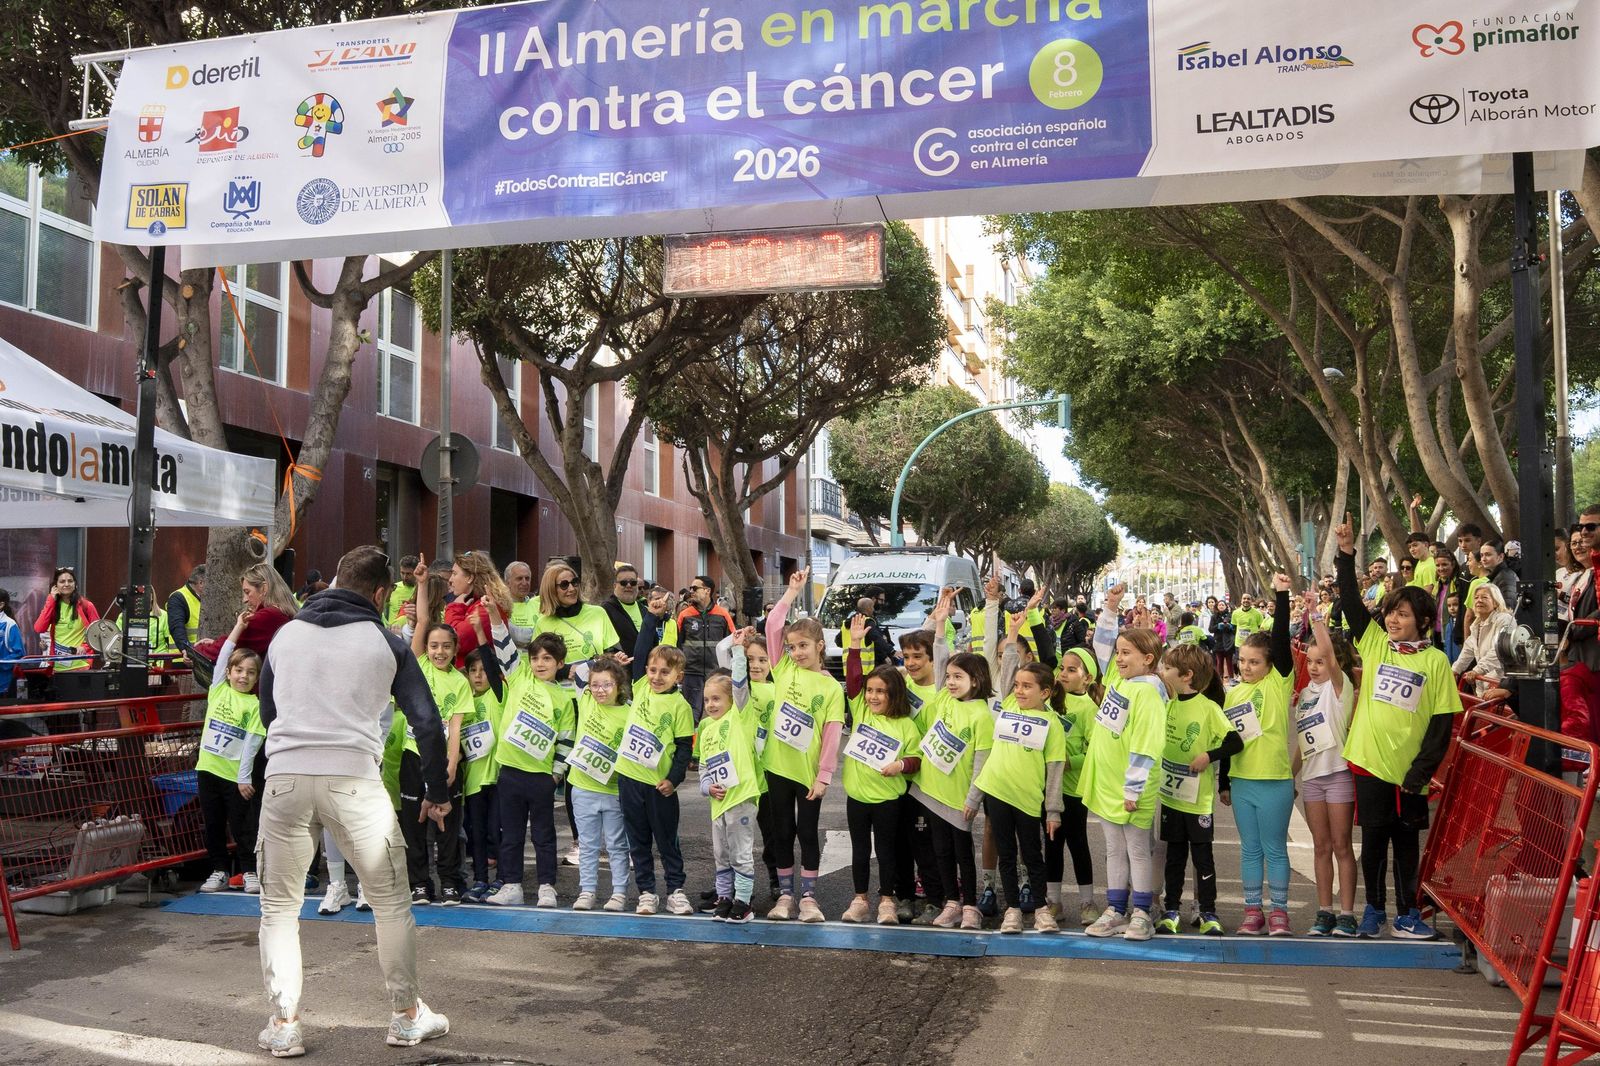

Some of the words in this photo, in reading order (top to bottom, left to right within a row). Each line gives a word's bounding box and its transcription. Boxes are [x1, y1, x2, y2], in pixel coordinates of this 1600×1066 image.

[1472, 11, 1574, 28] FUNDACIÓN
[336, 38, 390, 47] TRANSPORTES
[478, 32, 506, 77] II
[513, 8, 744, 72] Almería
[760, 7, 835, 48] en
[1472, 24, 1580, 52] primaflor
[1177, 47, 1248, 72] Isabel
[1255, 44, 1342, 66] Alonso
[192, 56, 260, 86] deretil
[1053, 51, 1078, 88] 8
[499, 86, 686, 141] contra
[706, 71, 765, 121] el
[783, 62, 1005, 116] cáncer
[1048, 88, 1083, 100] Febrero
[1468, 88, 1529, 104] Toyota
[1196, 103, 1336, 135] LEALTADIS
[1469, 106, 1539, 122] Alborán
[1544, 103, 1597, 118] Motor
[400, 131, 422, 141] 2005
[968, 122, 1043, 139] asociación
[1045, 117, 1107, 135] española
[970, 140, 1014, 154] contra
[1016, 137, 1029, 151] el
[1031, 135, 1079, 149] cáncer
[1226, 130, 1305, 146] ABOGADOS
[124, 147, 170, 160] ALMERÍA
[136, 159, 160, 167] CIUDAD
[970, 159, 989, 170] en
[992, 153, 1049, 169] Almería
[733, 145, 821, 182] 2026
[342, 182, 429, 199] UNIVERSIDAD
[495, 168, 668, 196] #TodosContraElCáncer
[135, 207, 146, 218] DE
[149, 206, 181, 218] CABRAS
[341, 199, 360, 213] DE
[363, 195, 427, 211] ALMERÍA
[1, 420, 178, 495] ndolamta
[1378, 678, 1413, 699] 570
[514, 723, 549, 751] 1408
[781, 719, 802, 737] 30
[1011, 722, 1033, 737] 19
[213, 733, 234, 748] 17
[464, 736, 482, 752] 16
[1304, 731, 1315, 745] 6
[629, 738, 654, 760] 578
[856, 739, 888, 761] 485
[928, 733, 957, 764] 1455
[575, 746, 612, 774] 1409
[1165, 773, 1185, 790] 27
